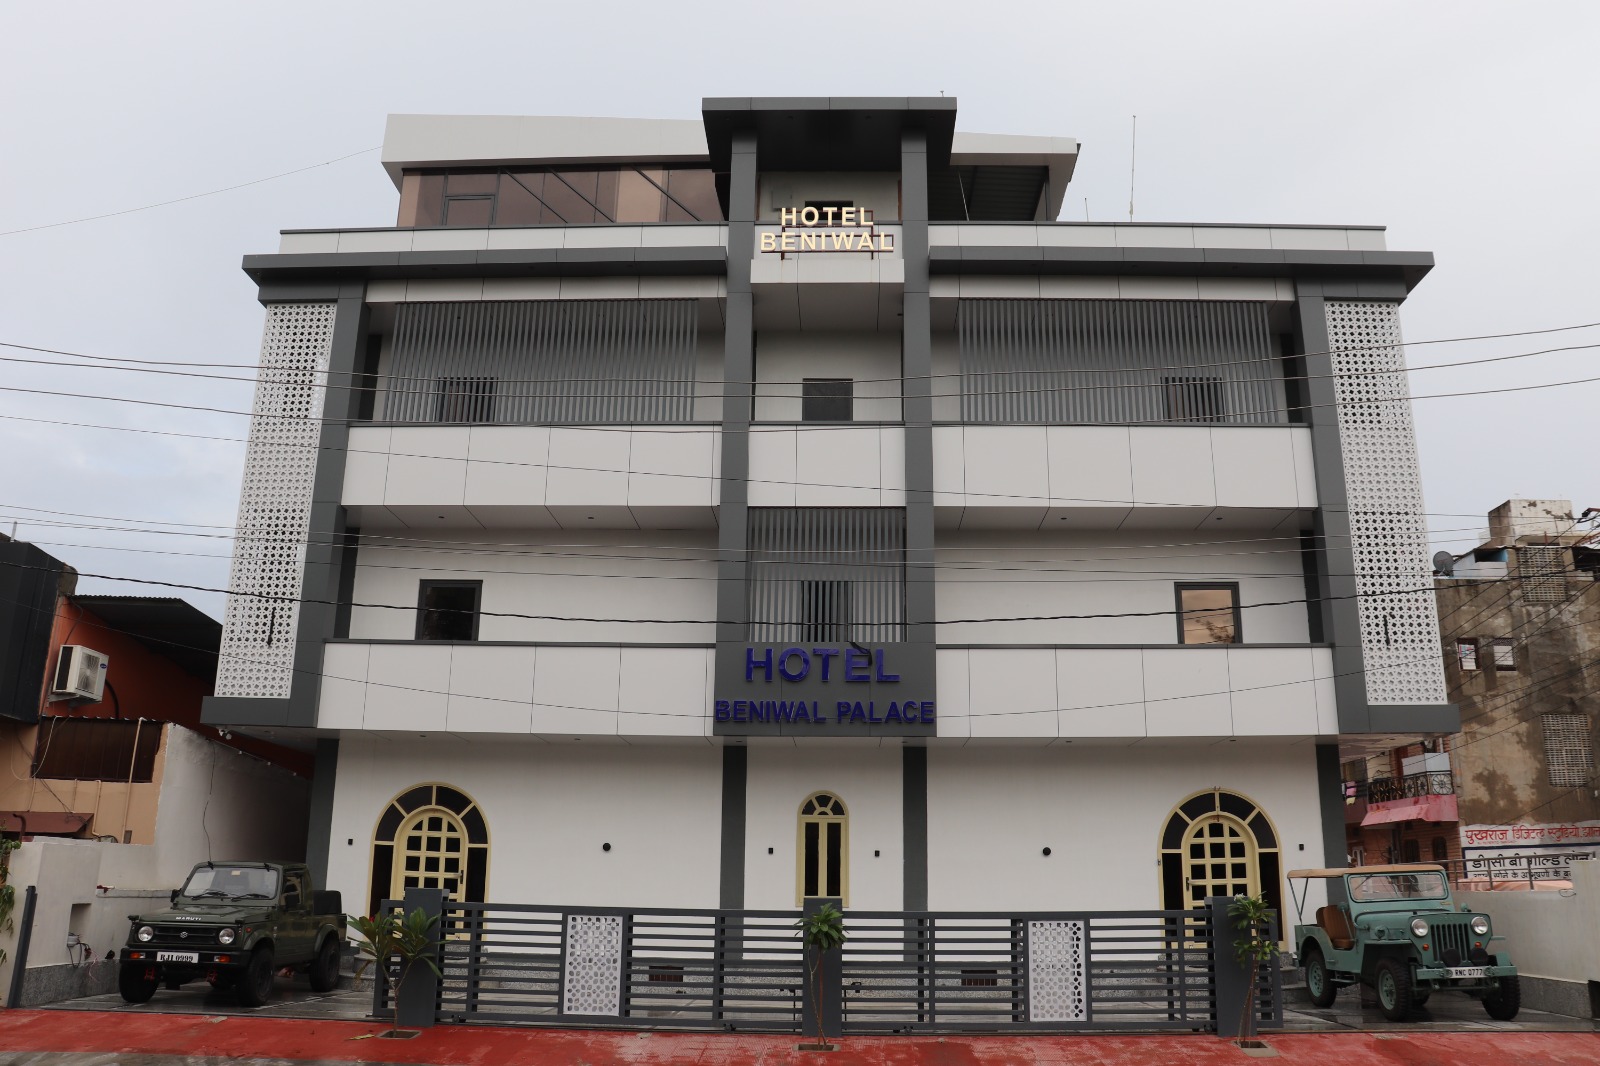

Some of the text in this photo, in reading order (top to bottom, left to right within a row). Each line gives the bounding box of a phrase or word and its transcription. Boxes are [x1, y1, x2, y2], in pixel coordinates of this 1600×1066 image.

[781, 206, 874, 227] HOTEL
[760, 231, 894, 252] BENIWAL
[745, 647, 901, 682] HOTEL
[715, 700, 935, 724] BENIWAL PALACE
[1465, 829, 1509, 844] पुखराज
